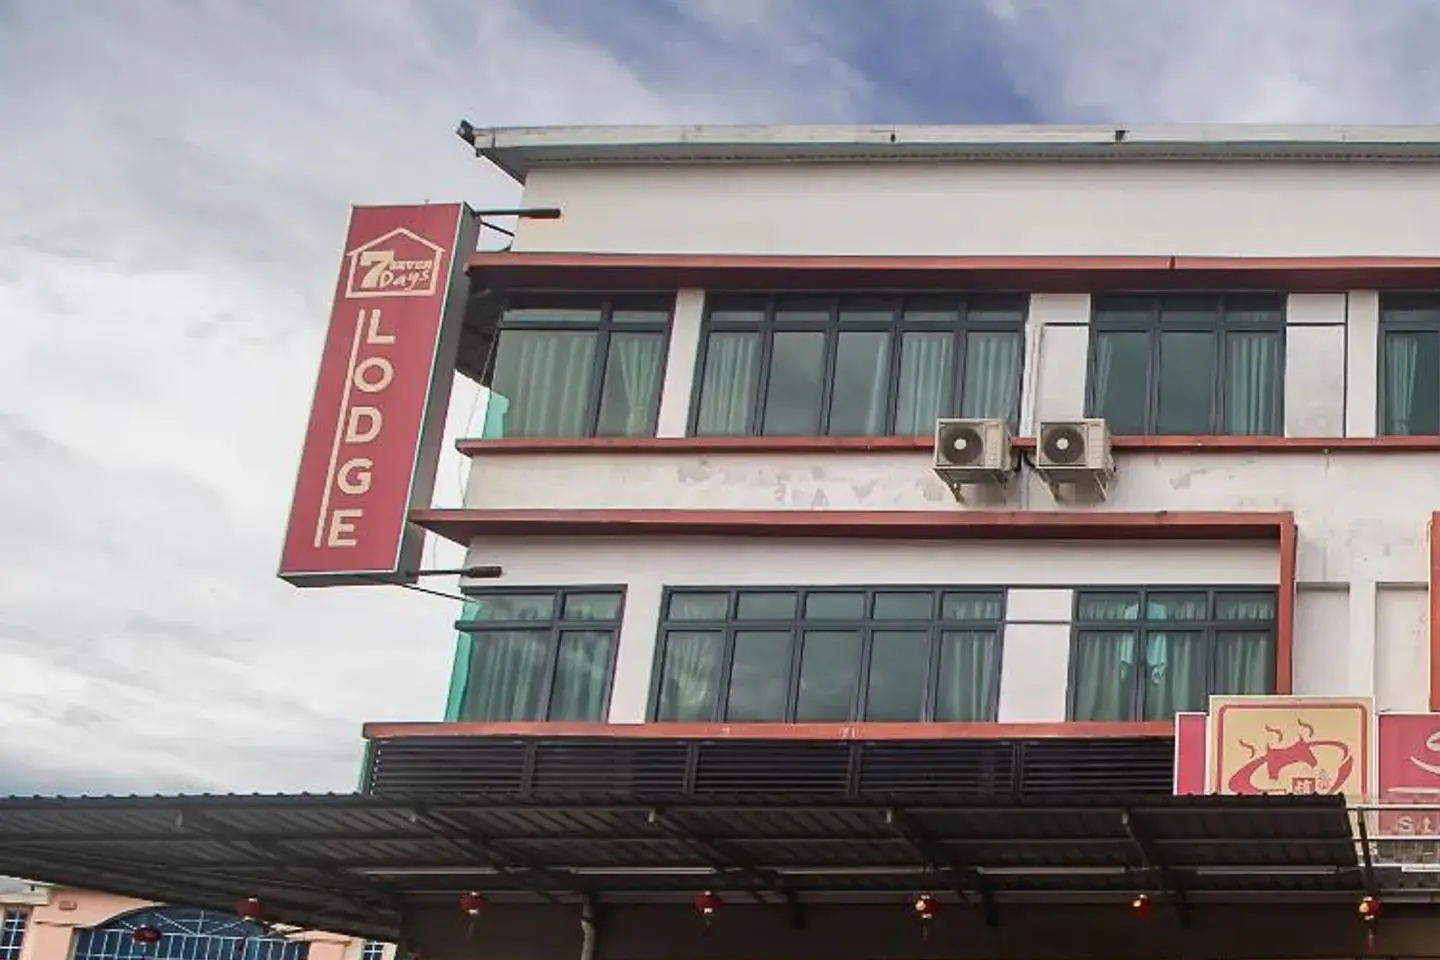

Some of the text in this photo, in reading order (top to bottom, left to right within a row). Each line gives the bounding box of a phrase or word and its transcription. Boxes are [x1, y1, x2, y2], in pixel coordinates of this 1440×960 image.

[360, 250, 395, 288] 7
[380, 269, 430, 291] Days
[326, 308, 396, 548] LODGE
